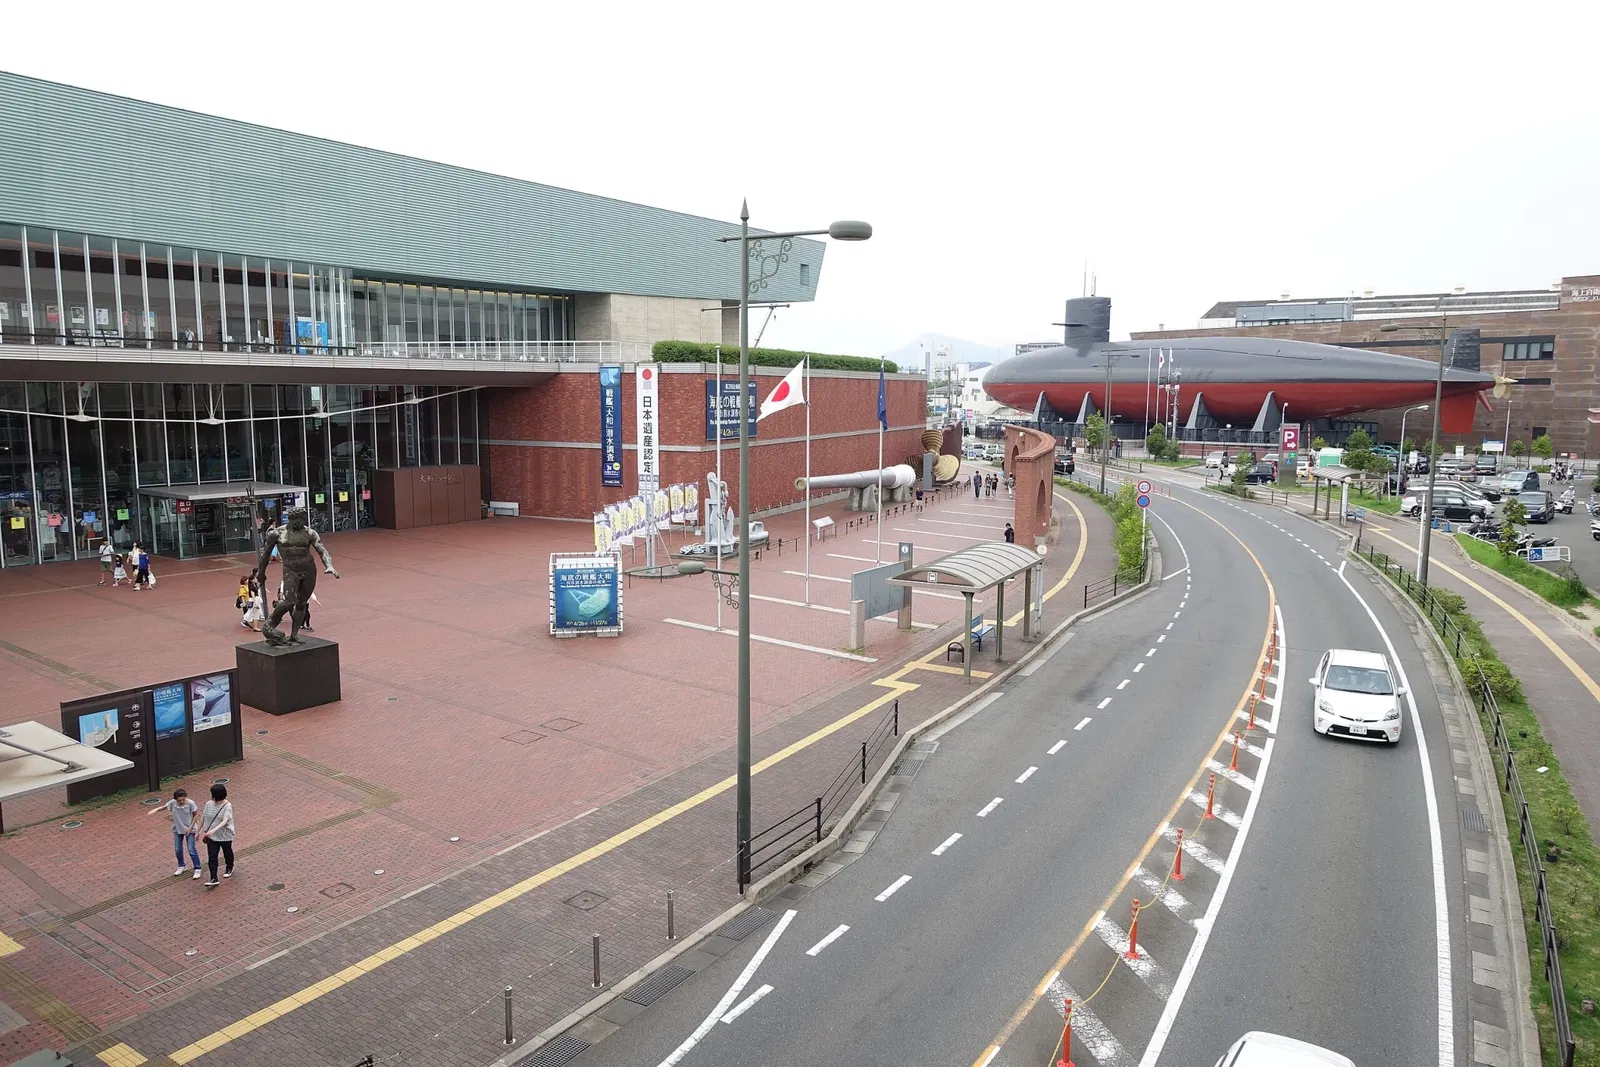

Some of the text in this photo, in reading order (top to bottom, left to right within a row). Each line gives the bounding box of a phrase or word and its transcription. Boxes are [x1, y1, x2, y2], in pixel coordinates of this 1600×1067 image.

[643, 396, 653, 473] 日本遺産認定
[1284, 430, 1295, 443] P
[1140, 483, 1149, 491] 40
[560, 573, 612, 581] 海底の戦艦大和
